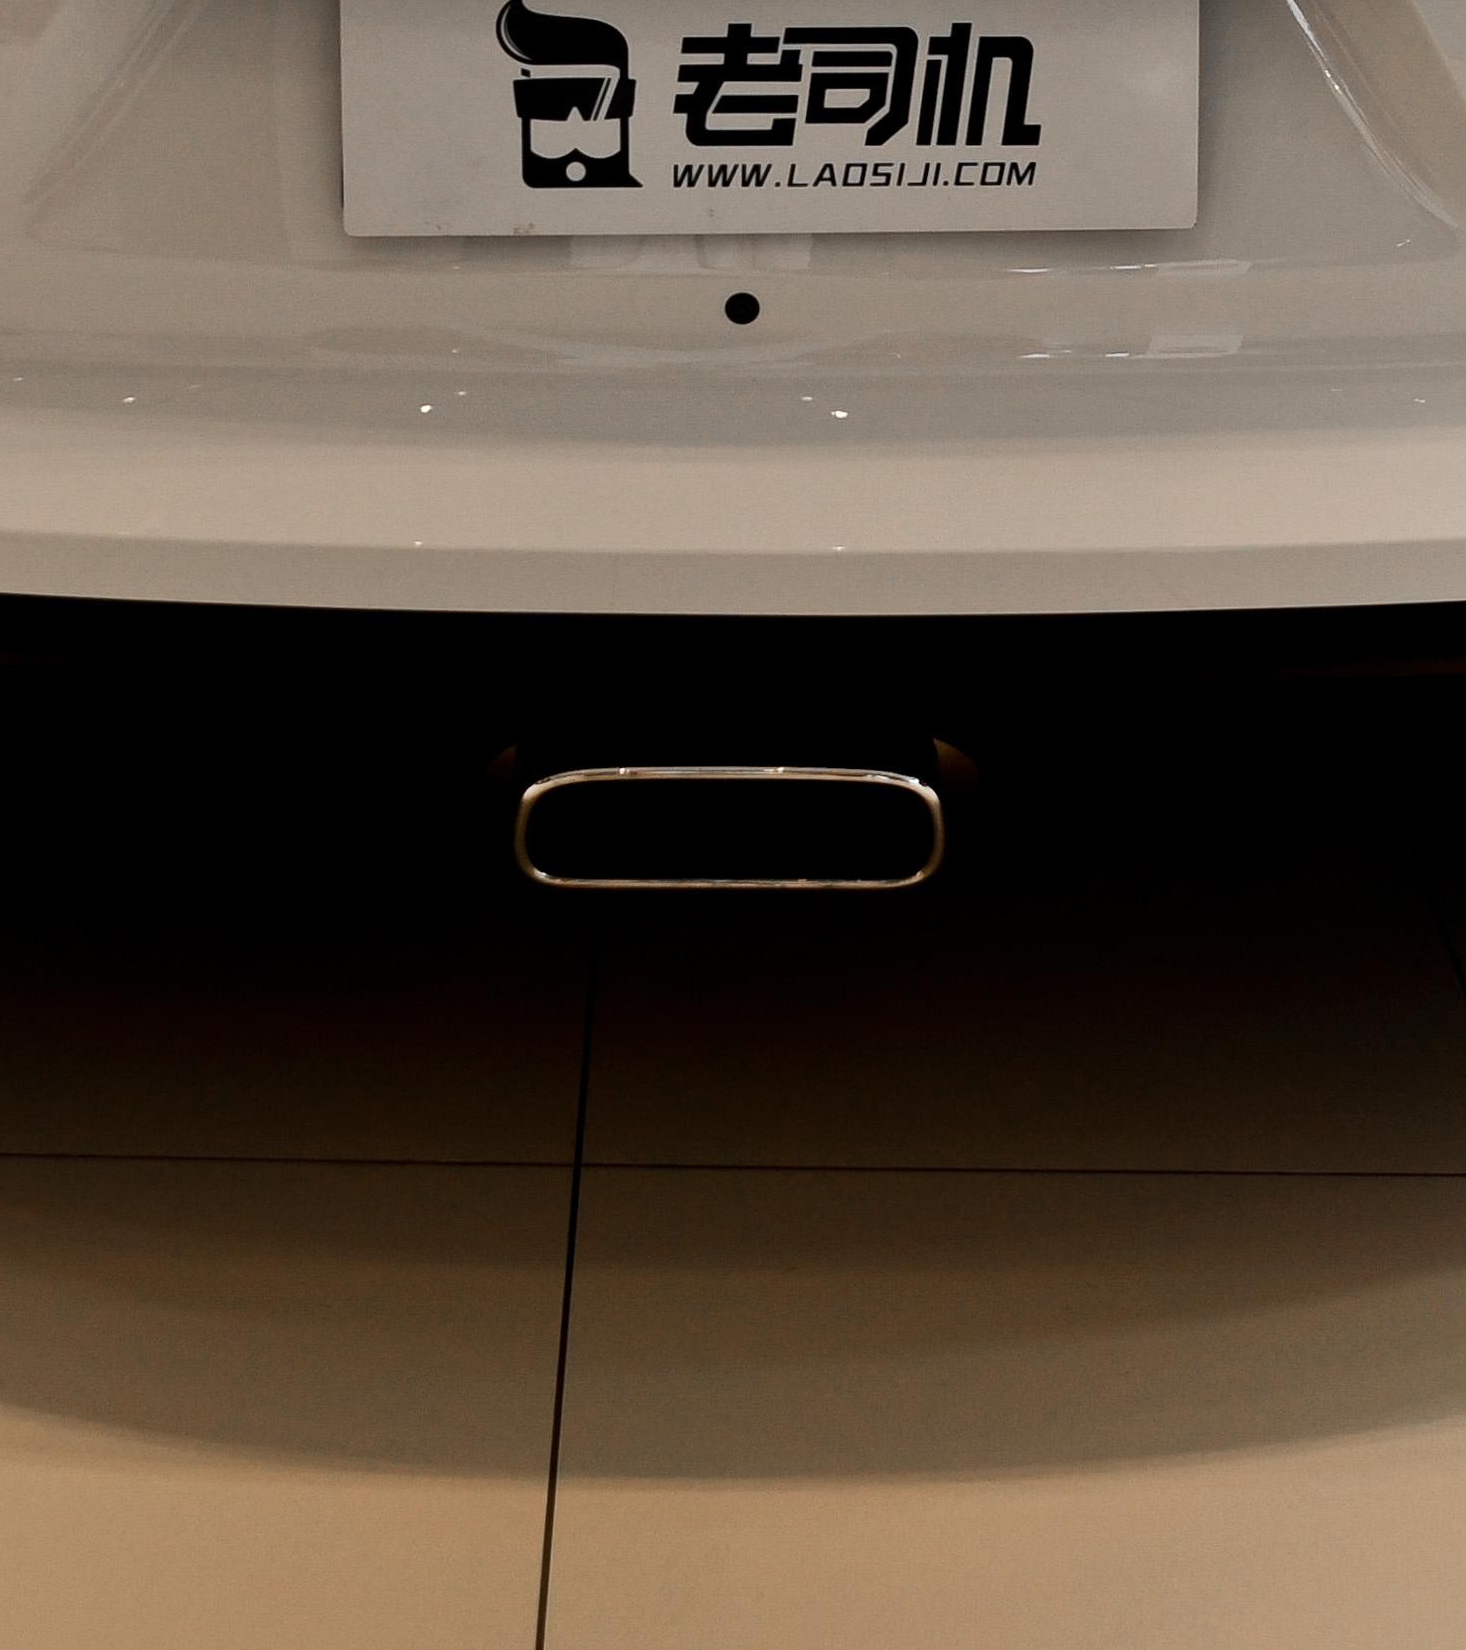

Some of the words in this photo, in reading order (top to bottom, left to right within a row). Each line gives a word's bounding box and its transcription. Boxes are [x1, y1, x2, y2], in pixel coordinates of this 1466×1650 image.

[672, 21, 1043, 147] 老司机
[672, 161, 1038, 189] WWW.LAOSIJI.COM
